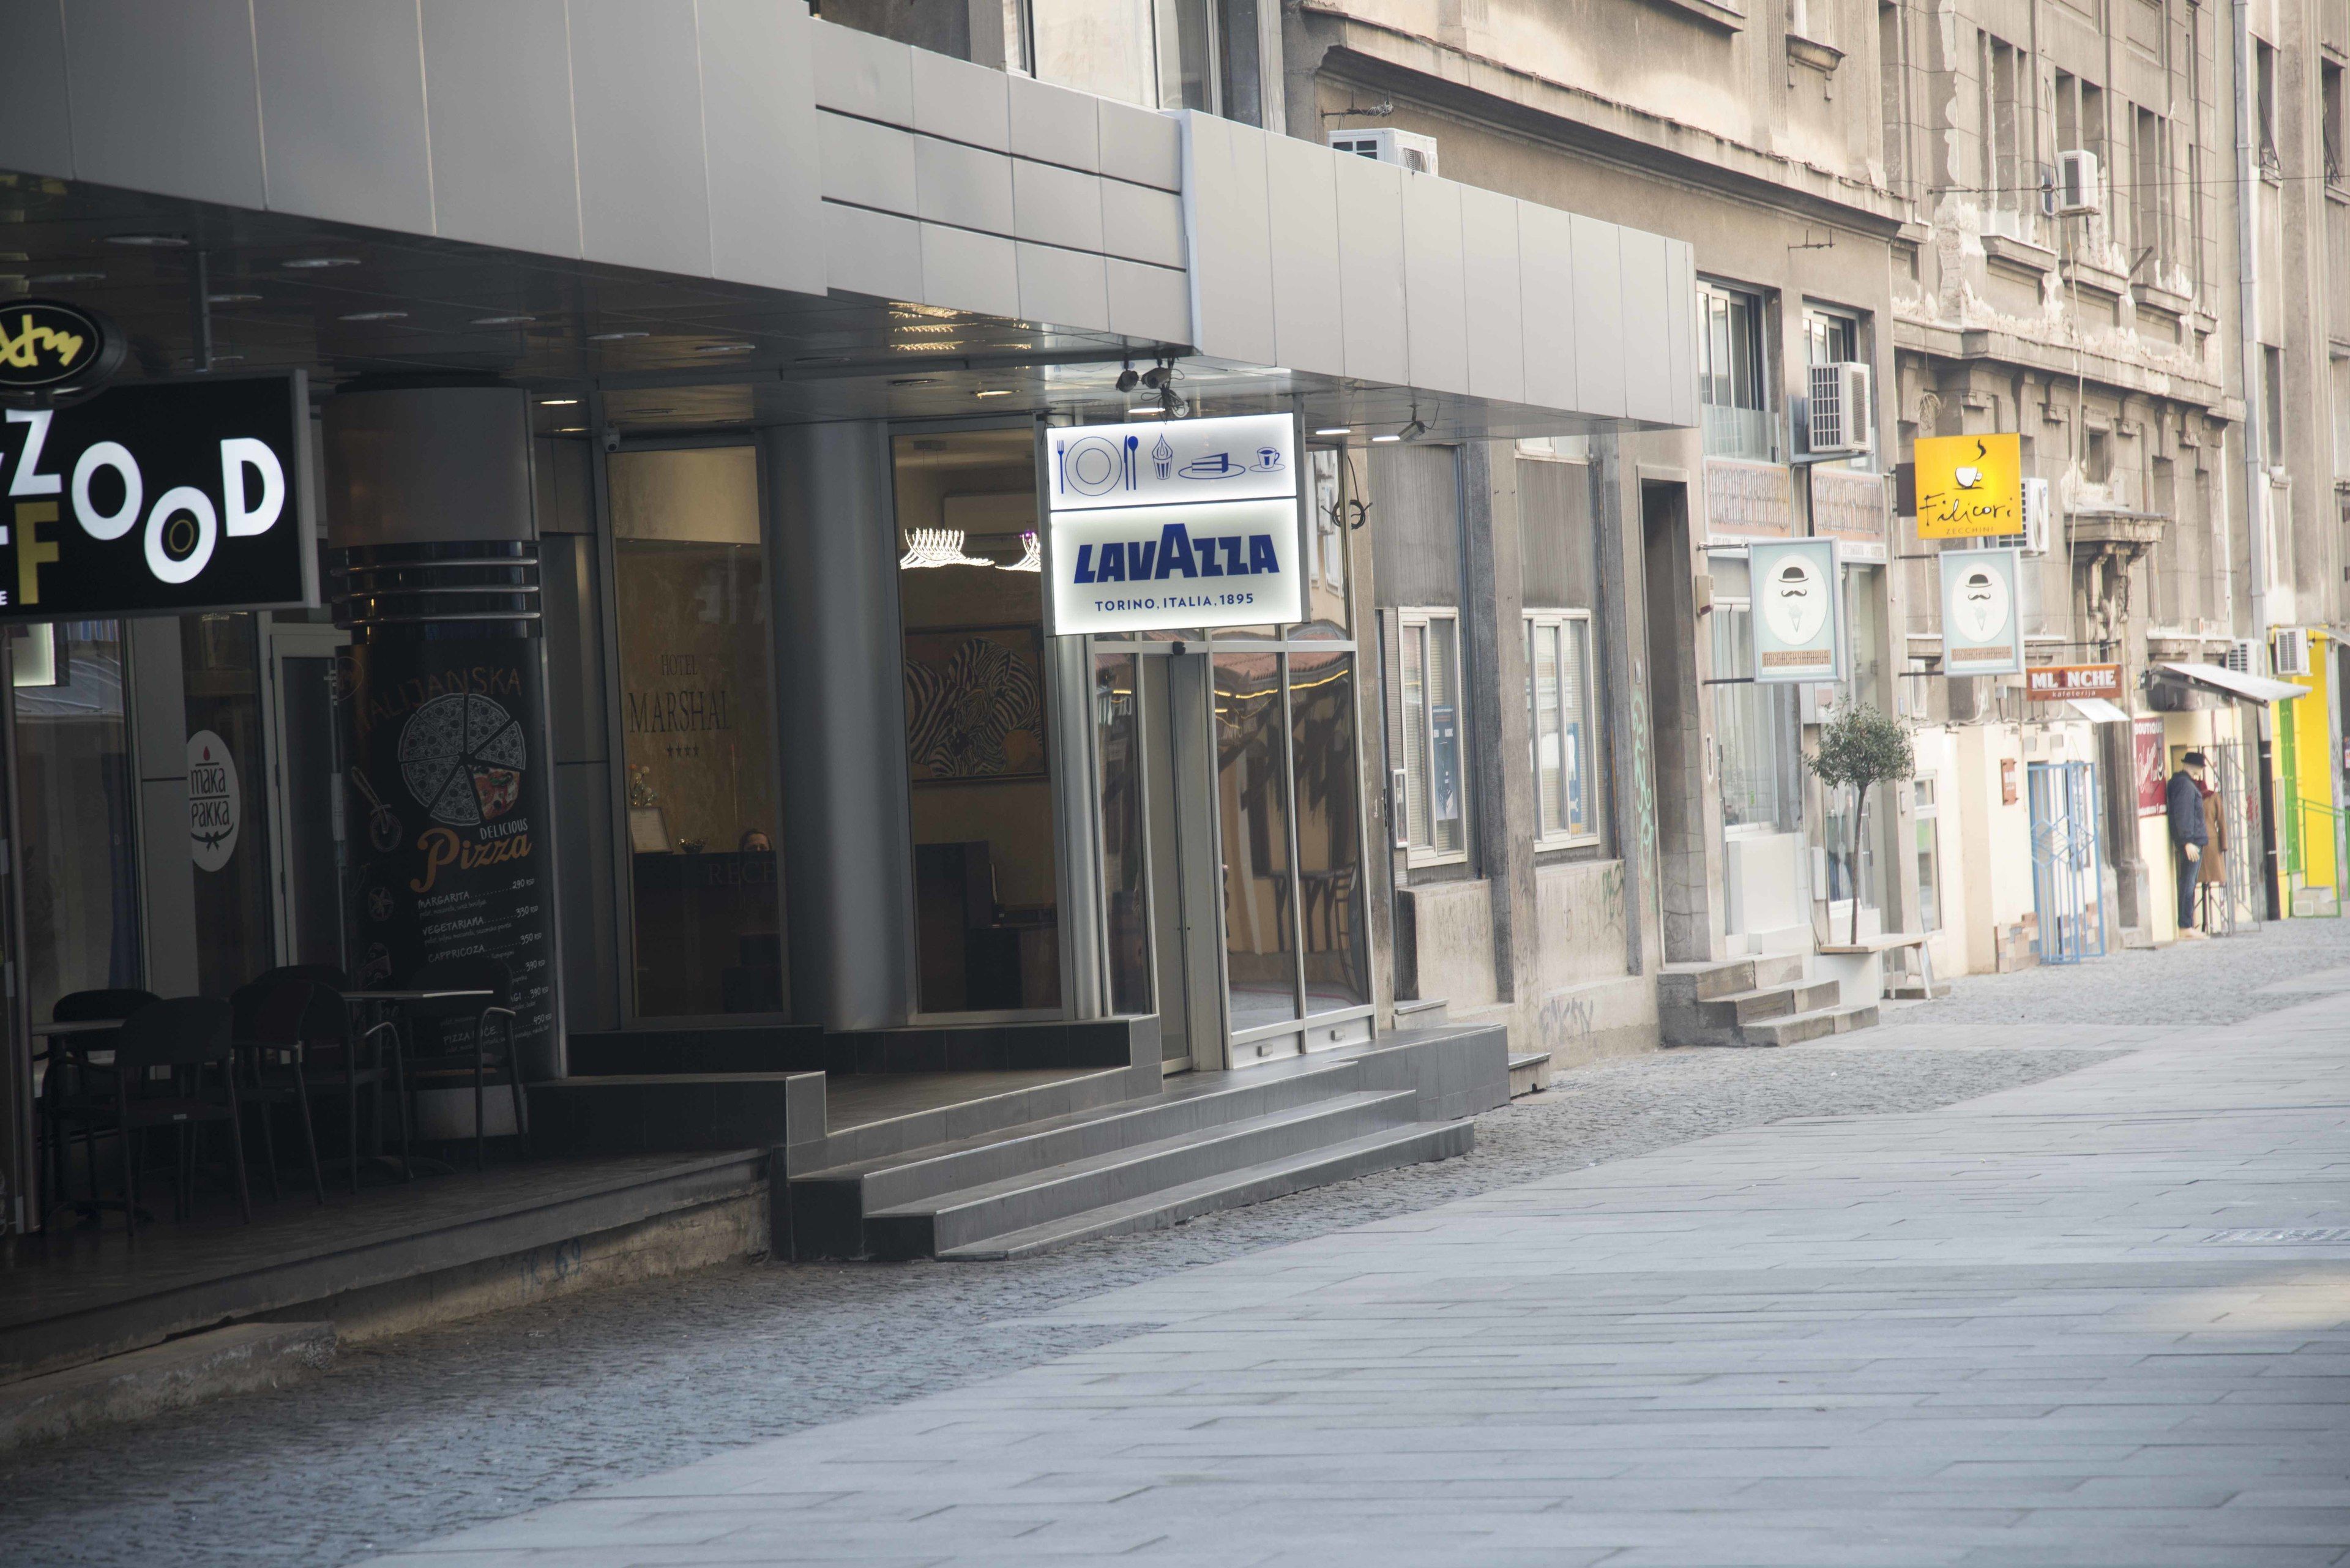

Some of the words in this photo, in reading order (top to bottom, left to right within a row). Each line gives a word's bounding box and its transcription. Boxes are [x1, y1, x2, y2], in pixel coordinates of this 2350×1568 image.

[1919, 492, 2012, 526] Filicori
[1945, 526, 1994, 535] ZECCHINI
[1073, 523, 1280, 584] LAVAZZA
[1219, 592, 1254, 605] 1895
[661, 654, 698, 676] HOTEL
[2052, 690, 2096, 698] kafeterija
[629, 690, 731, 733] MARSHAL
[2134, 721, 2163, 735] BOUTIQUE
[479, 818, 529, 840] DELICIOUS
[409, 826, 532, 893] Pizza
[417, 890, 470, 909] MARGARITA
[512, 878, 525, 889] 290
[422, 916, 484, 936] VEGETARIANA
[515, 906, 529, 918] 330
[428, 944, 485, 963] CAPPRICOZA
[520, 933, 534, 946] 350
[443, 1033, 470, 1045] PIZZA
